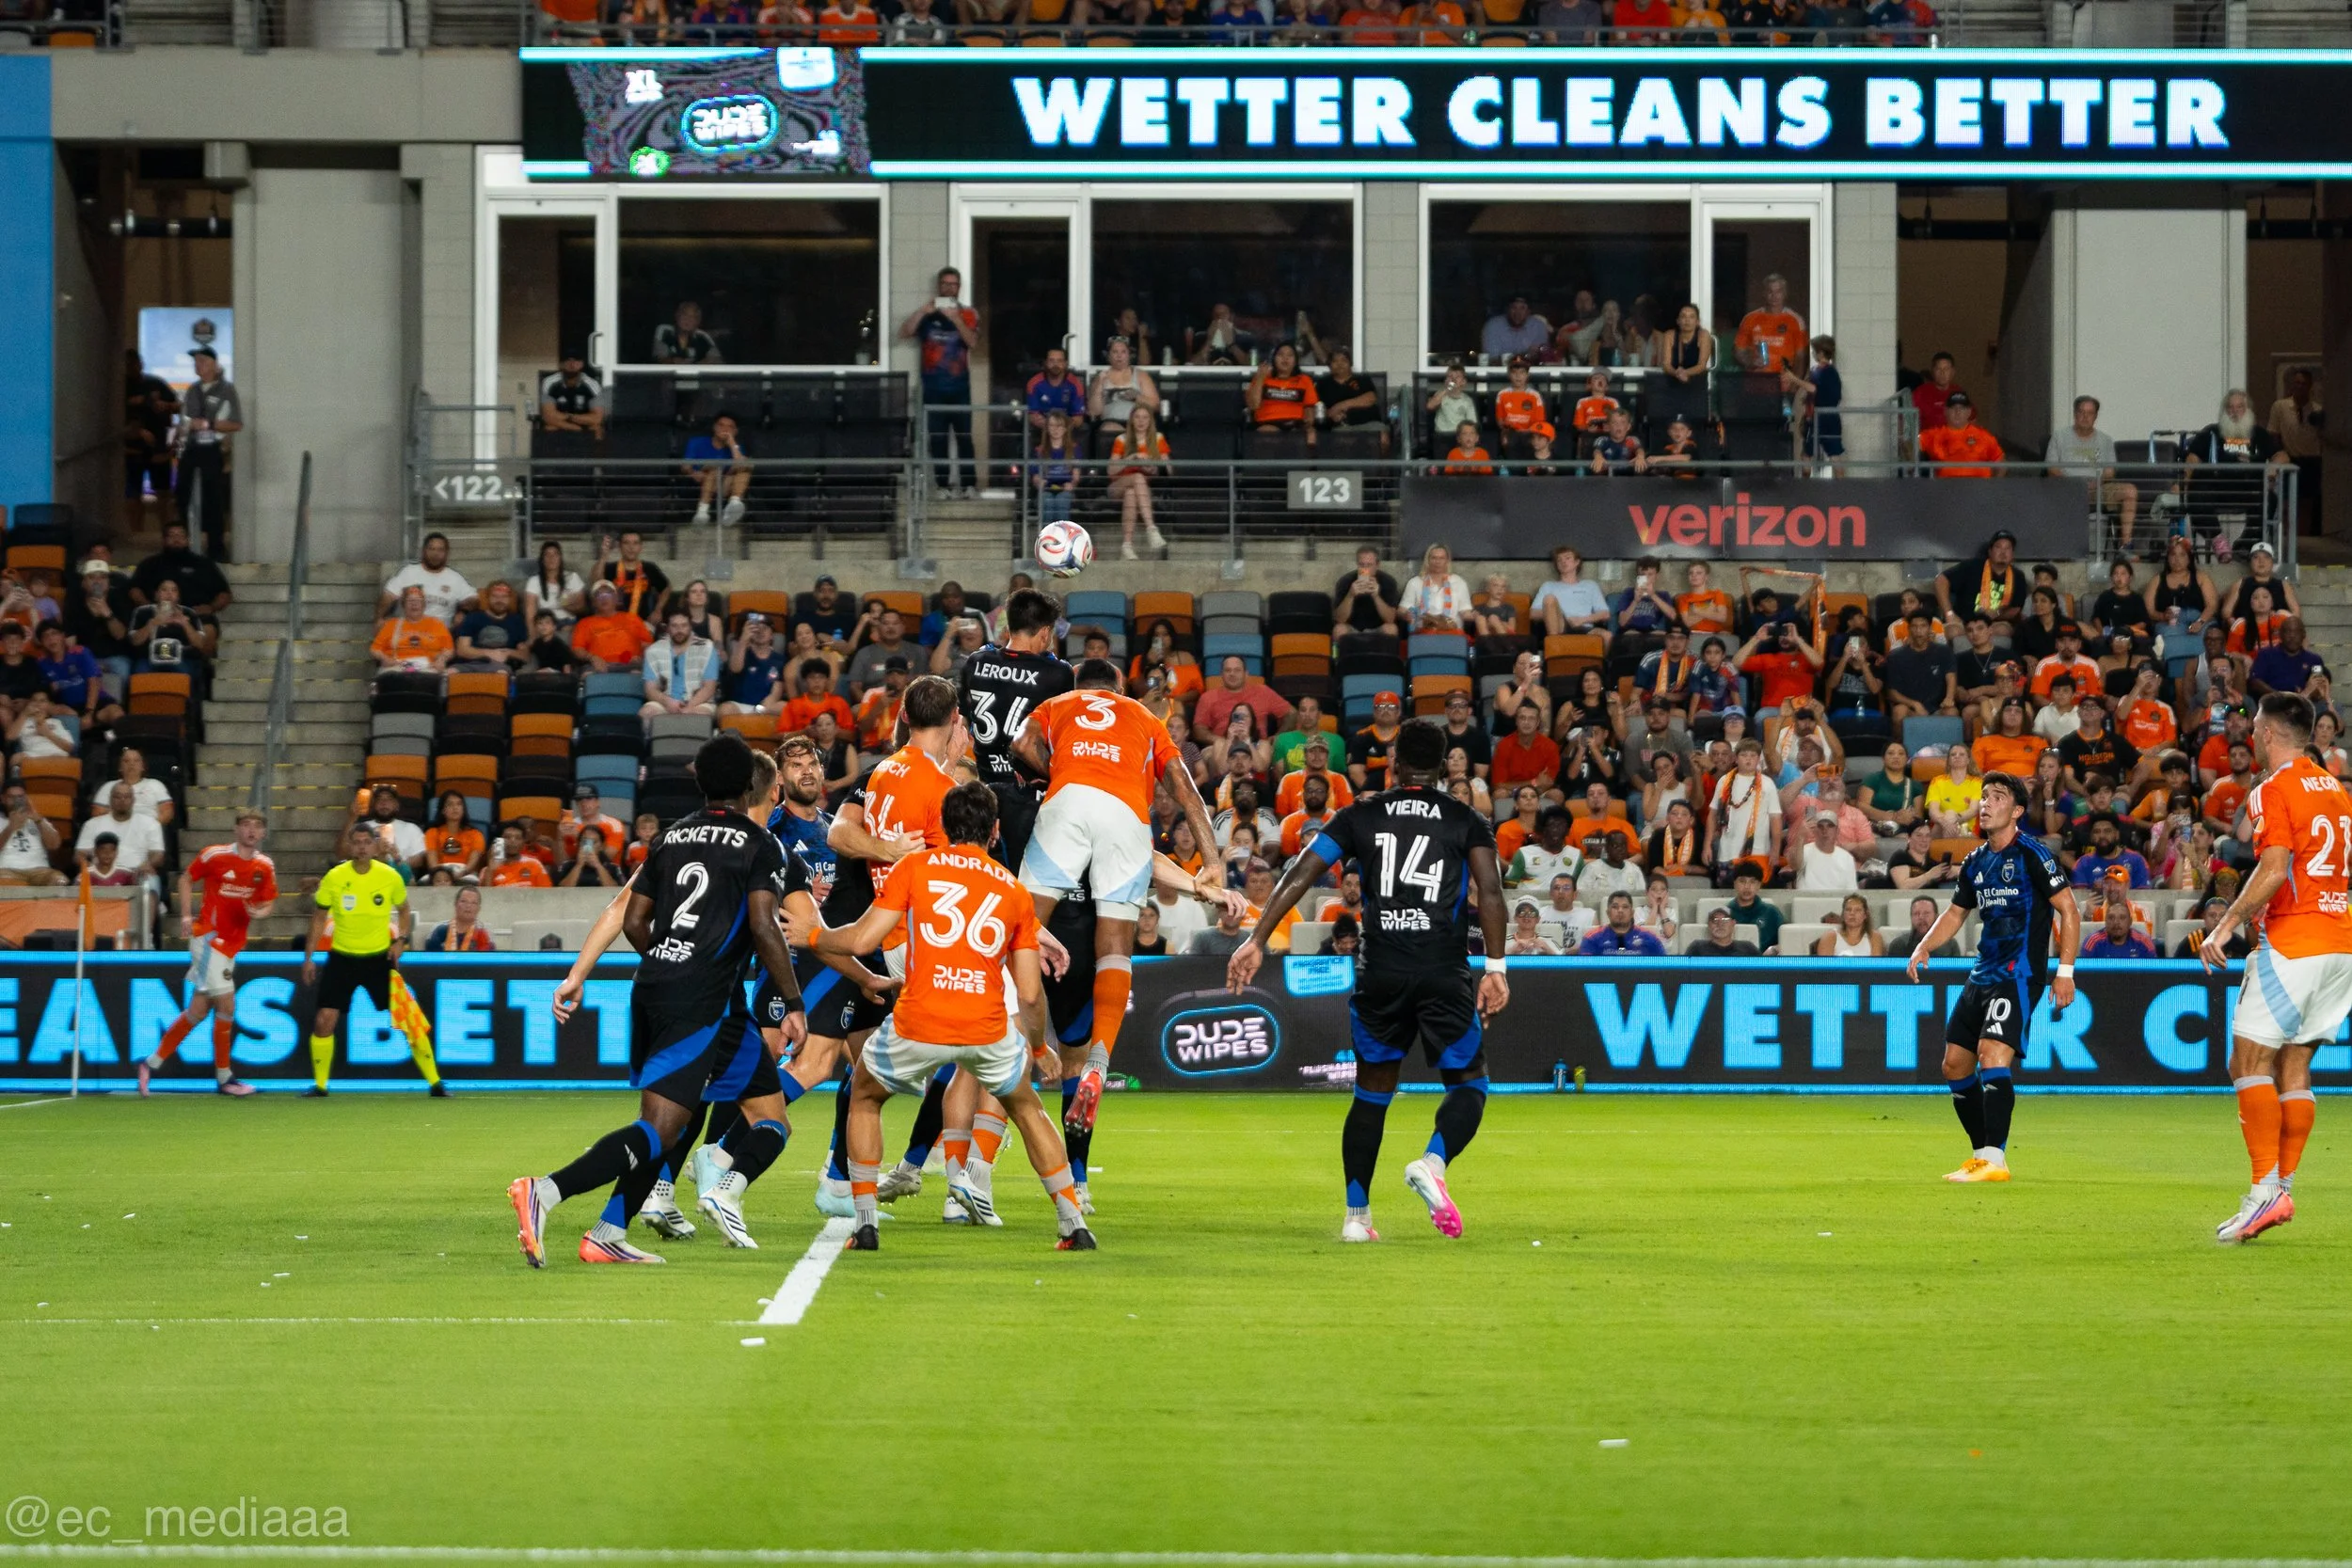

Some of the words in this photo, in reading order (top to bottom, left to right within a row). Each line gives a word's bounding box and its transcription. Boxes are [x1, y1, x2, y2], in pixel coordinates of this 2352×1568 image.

[1011, 77, 1417, 147] WETTER
[1447, 75, 1833, 149] CLEANS
[1866, 77, 2230, 148] BETTER
[1299, 477, 1350, 503] 123
[1628, 492, 1867, 547] verizon
[974, 661, 1040, 686] LEROUX
[1074, 693, 1117, 731] 3
[1073, 741, 1121, 753] DUDE
[1073, 749, 1121, 764] WIPES
[1385, 800, 1442, 820] VIEIRA
[663, 825, 749, 847] RICKETTS
[2306, 814, 2352, 878] 21
[927, 852, 1017, 889] ANDRADE
[1375, 832, 1445, 903] 14
[671, 862, 709, 930] 2
[1983, 887, 1992, 897] El
[1991, 887, 2020, 897] Camino
[1985, 895, 2008, 907] Health
[2318, 891, 2348, 905] DUDE
[919, 879, 1007, 958] 36
[1380, 908, 1431, 922] DUDE
[2318, 902, 2348, 913] WIPES
[1381, 919, 1432, 931] WIPES
[932, 977, 987, 995] WIPES
[933, 964, 987, 983] DUDE
[1985, 997, 2011, 1022] 10
[1174, 1016, 1268, 1046] DUDE
[1583, 982, 2099, 1071] WETTR
[1178, 1037, 1270, 1064] WIPES
